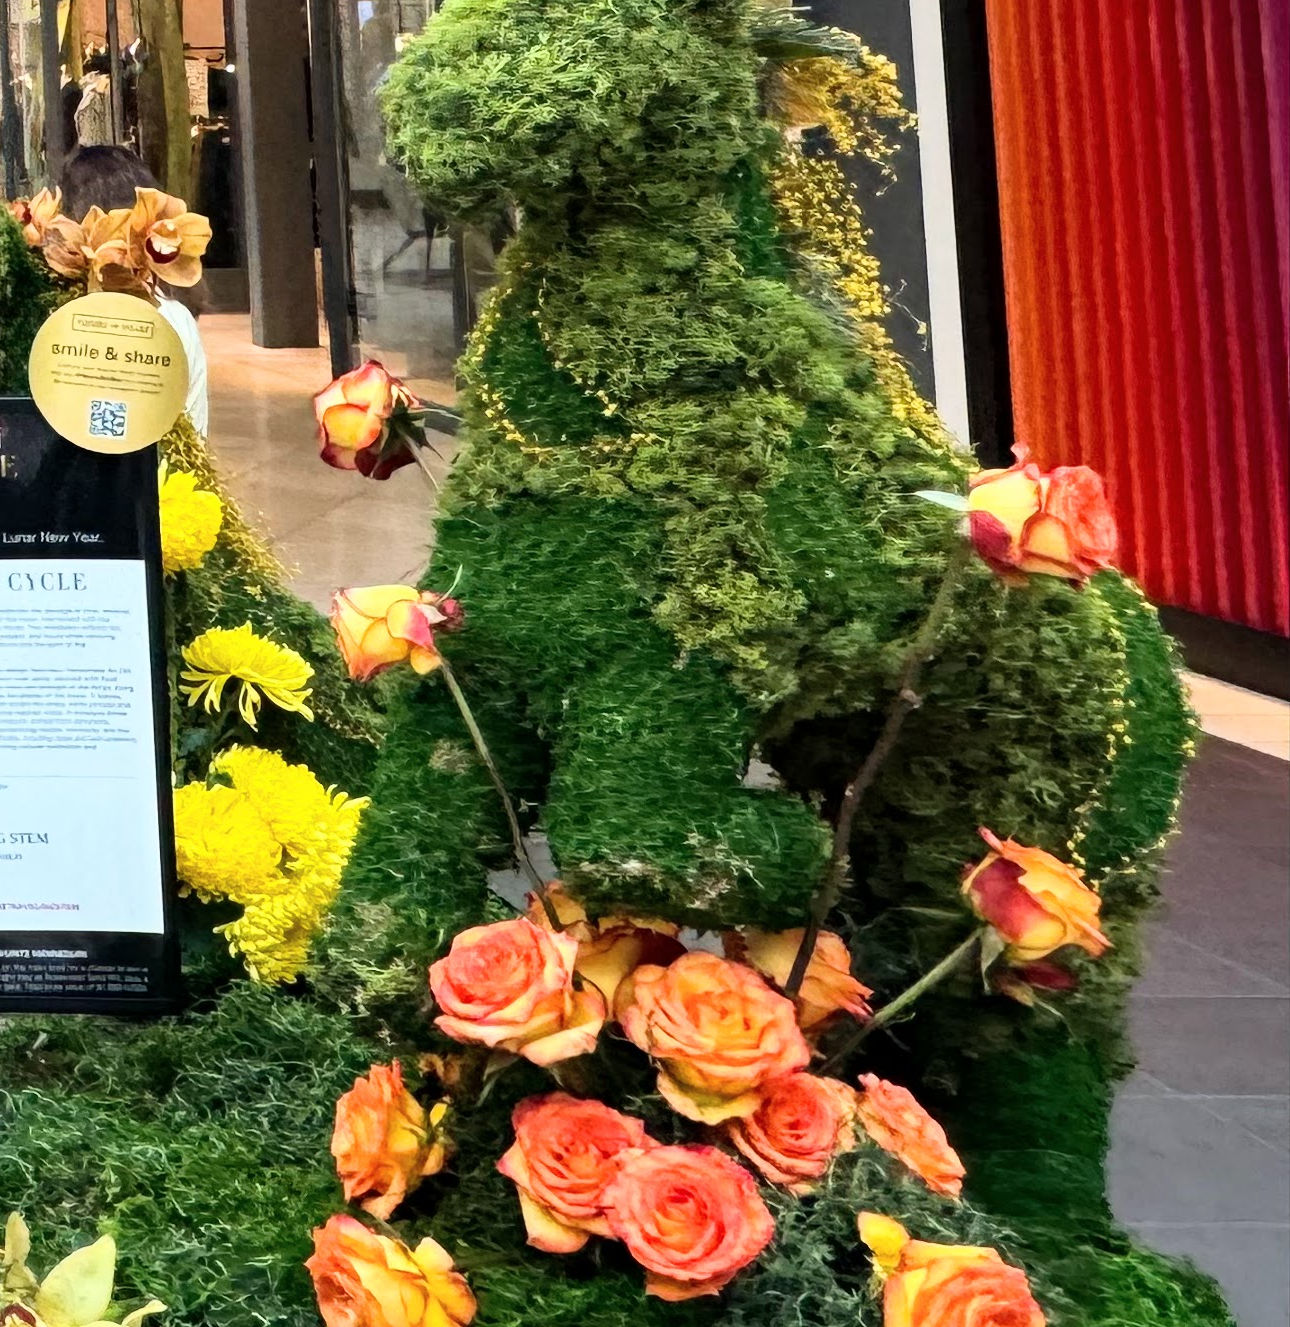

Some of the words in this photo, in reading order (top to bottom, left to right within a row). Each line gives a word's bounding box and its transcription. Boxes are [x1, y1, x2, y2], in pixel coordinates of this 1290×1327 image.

[52, 343, 99, 360] smile
[105, 346, 118, 361] &
[124, 350, 171, 367] share
[3, 532, 37, 543] Lunar
[40, 531, 70, 543] New
[8, 572, 88, 591] CYCLE
[9, 832, 49, 844] STEM
